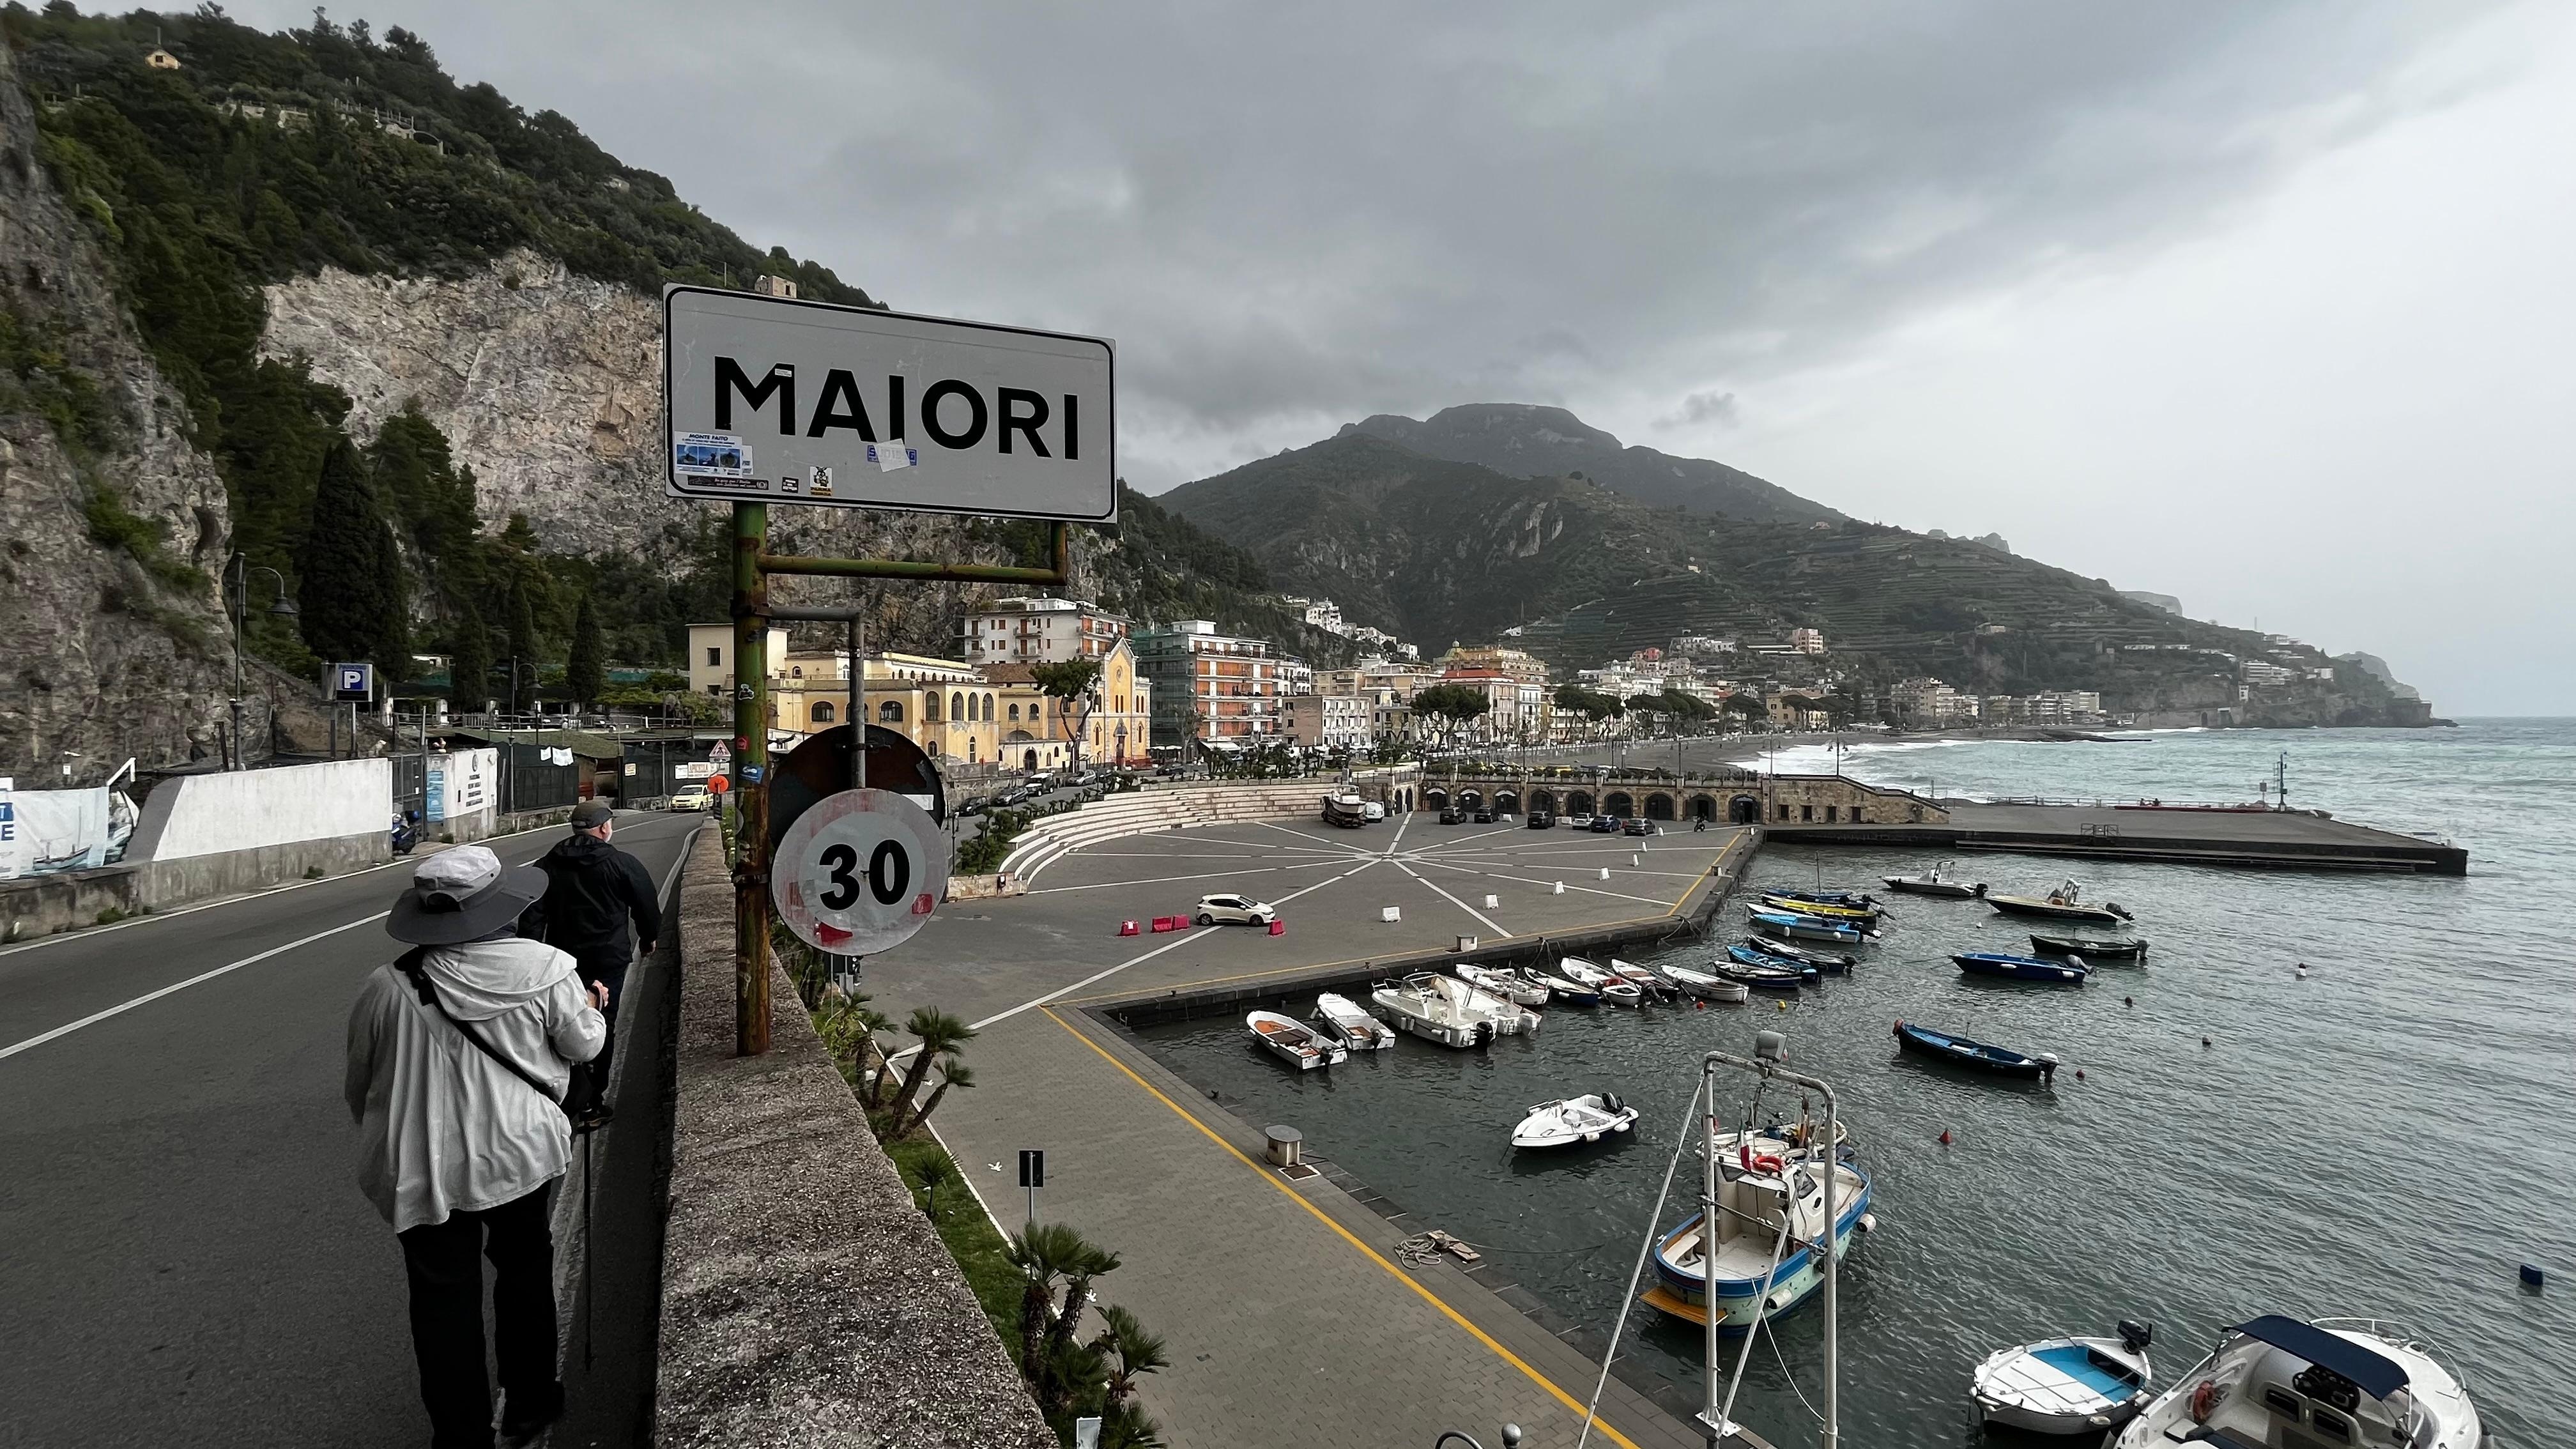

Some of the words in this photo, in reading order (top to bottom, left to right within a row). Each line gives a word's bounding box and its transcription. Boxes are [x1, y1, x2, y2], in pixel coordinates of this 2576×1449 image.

[714, 356, 1078, 460] MAIORI
[344, 671, 361, 689] P
[1, 824, 15, 841] E
[818, 839, 910, 911] 30
